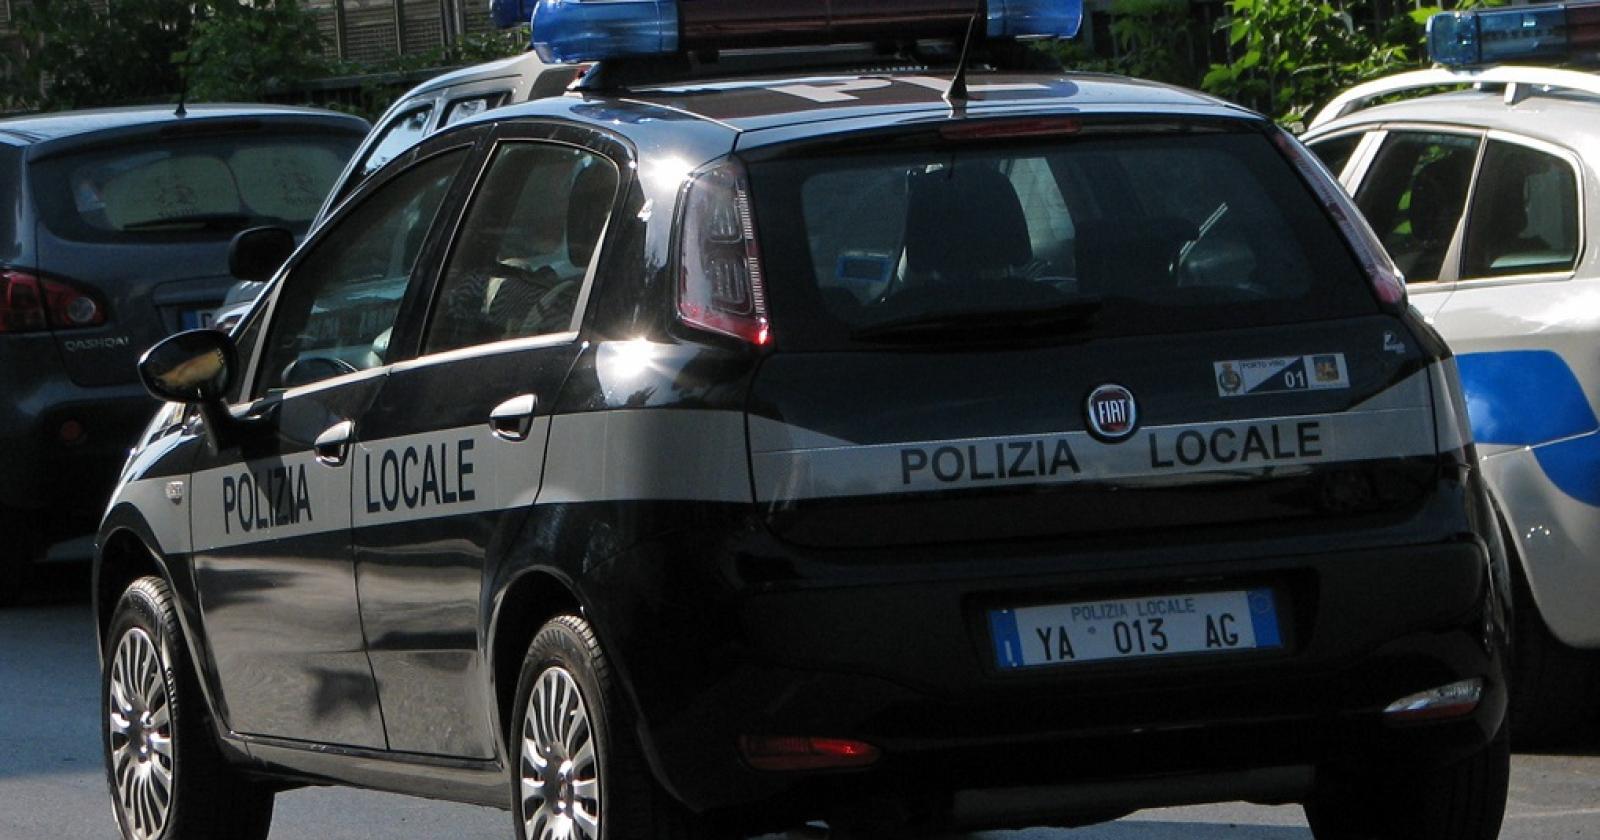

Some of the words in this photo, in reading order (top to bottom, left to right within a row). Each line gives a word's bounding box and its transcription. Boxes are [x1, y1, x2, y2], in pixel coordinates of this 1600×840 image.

[1284, 371, 1305, 388] 01
[1097, 399, 1126, 425] FIAT
[901, 439, 1080, 485] POLIZIA
[1150, 422, 1322, 468] LOCALE
[223, 463, 313, 534] POLIZIA
[365, 438, 475, 514] LOCALE
[1071, 605, 1127, 622] POLIZIA
[1138, 598, 1196, 616] LOCALE
[1036, 625, 1075, 660] YA
[1113, 618, 1168, 654] 013
[1206, 612, 1238, 648] AG
